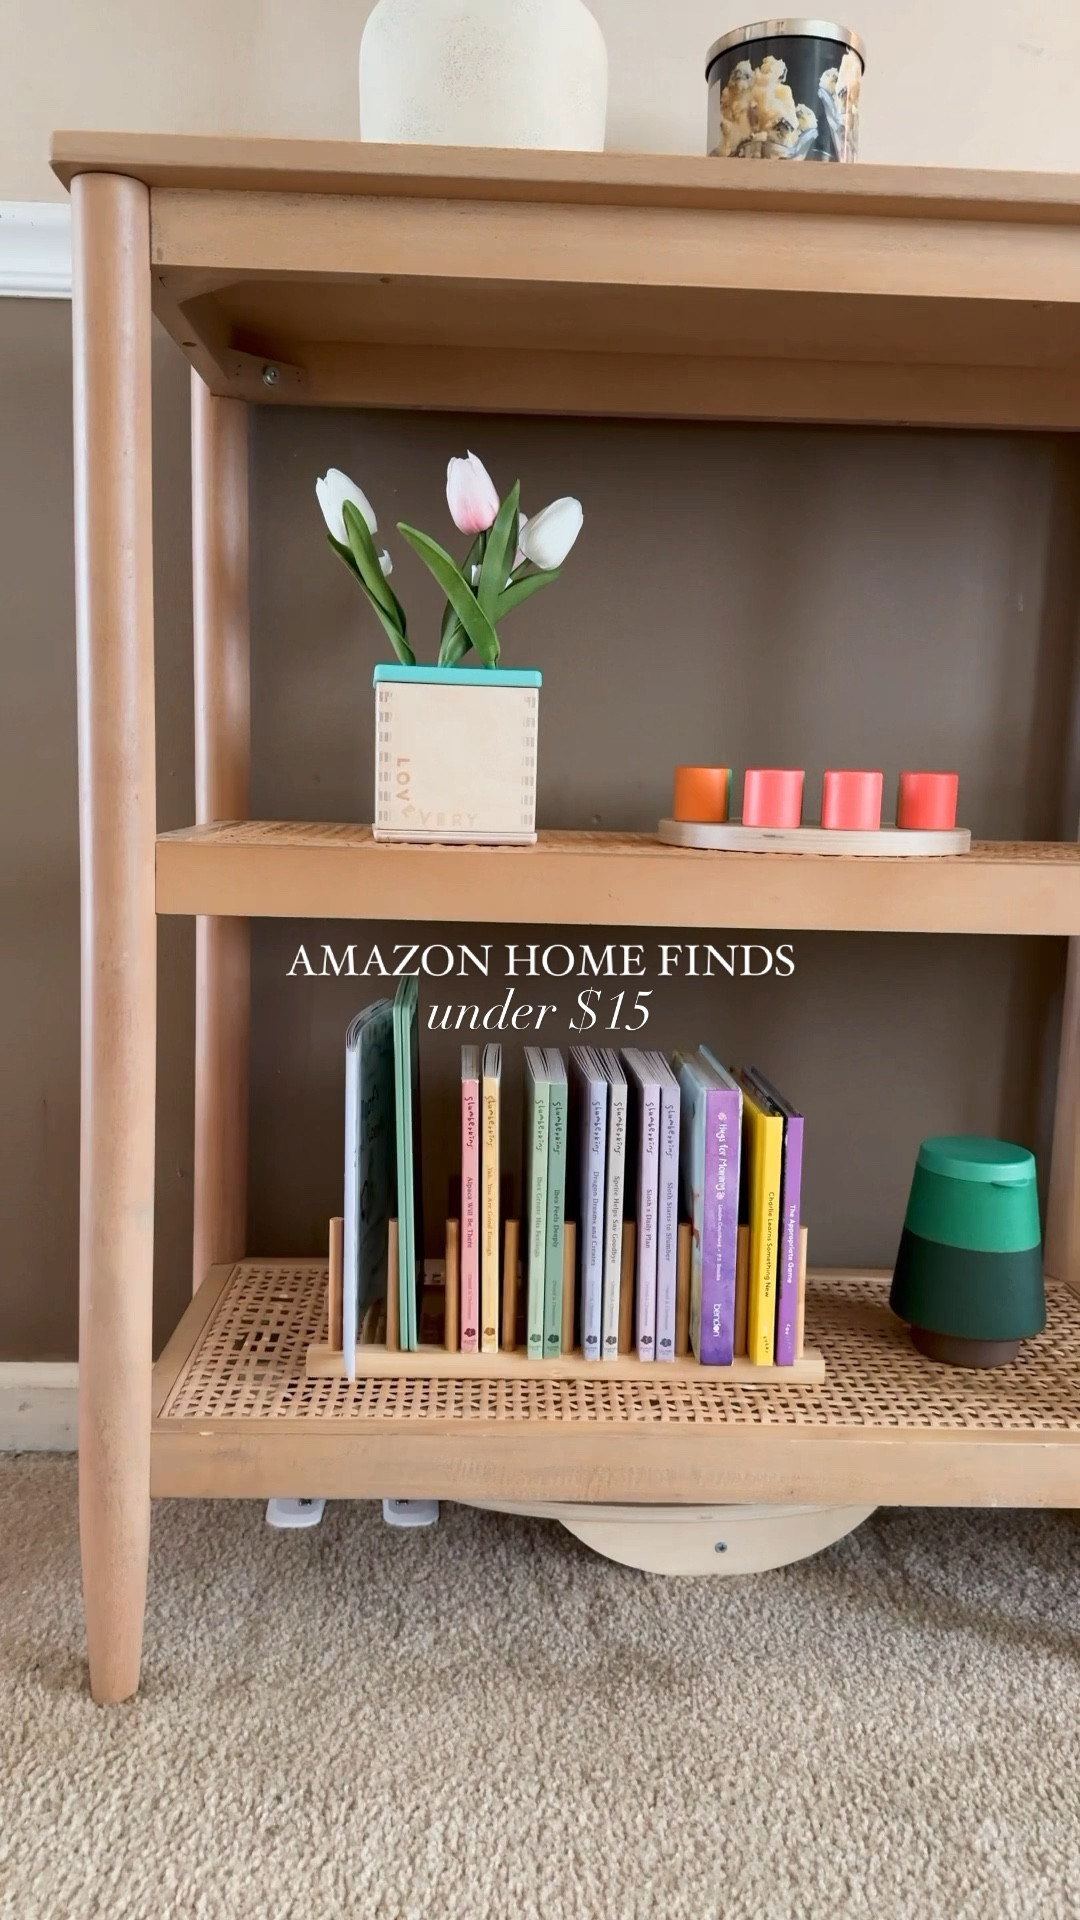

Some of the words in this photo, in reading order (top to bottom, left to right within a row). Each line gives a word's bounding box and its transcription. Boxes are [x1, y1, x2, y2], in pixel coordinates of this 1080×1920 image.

[715, 1123, 728, 1142] Hugs
[719, 1144, 728, 1155] for
[612, 1175, 620, 1196] Sprite
[715, 1158, 727, 1190] Mommy
[611, 1198, 619, 1218] Helps
[767, 1191, 775, 1217] Charlie
[467, 1218, 473, 1227] Be
[610, 1233, 618, 1264] Goodbye
[665, 1232, 673, 1261] Slumber
[788, 1218, 796, 1261] Appropriate
[763, 1243, 772, 1280] Something
[786, 1262, 794, 1284] Game
[713, 1303, 722, 1337] bendon
